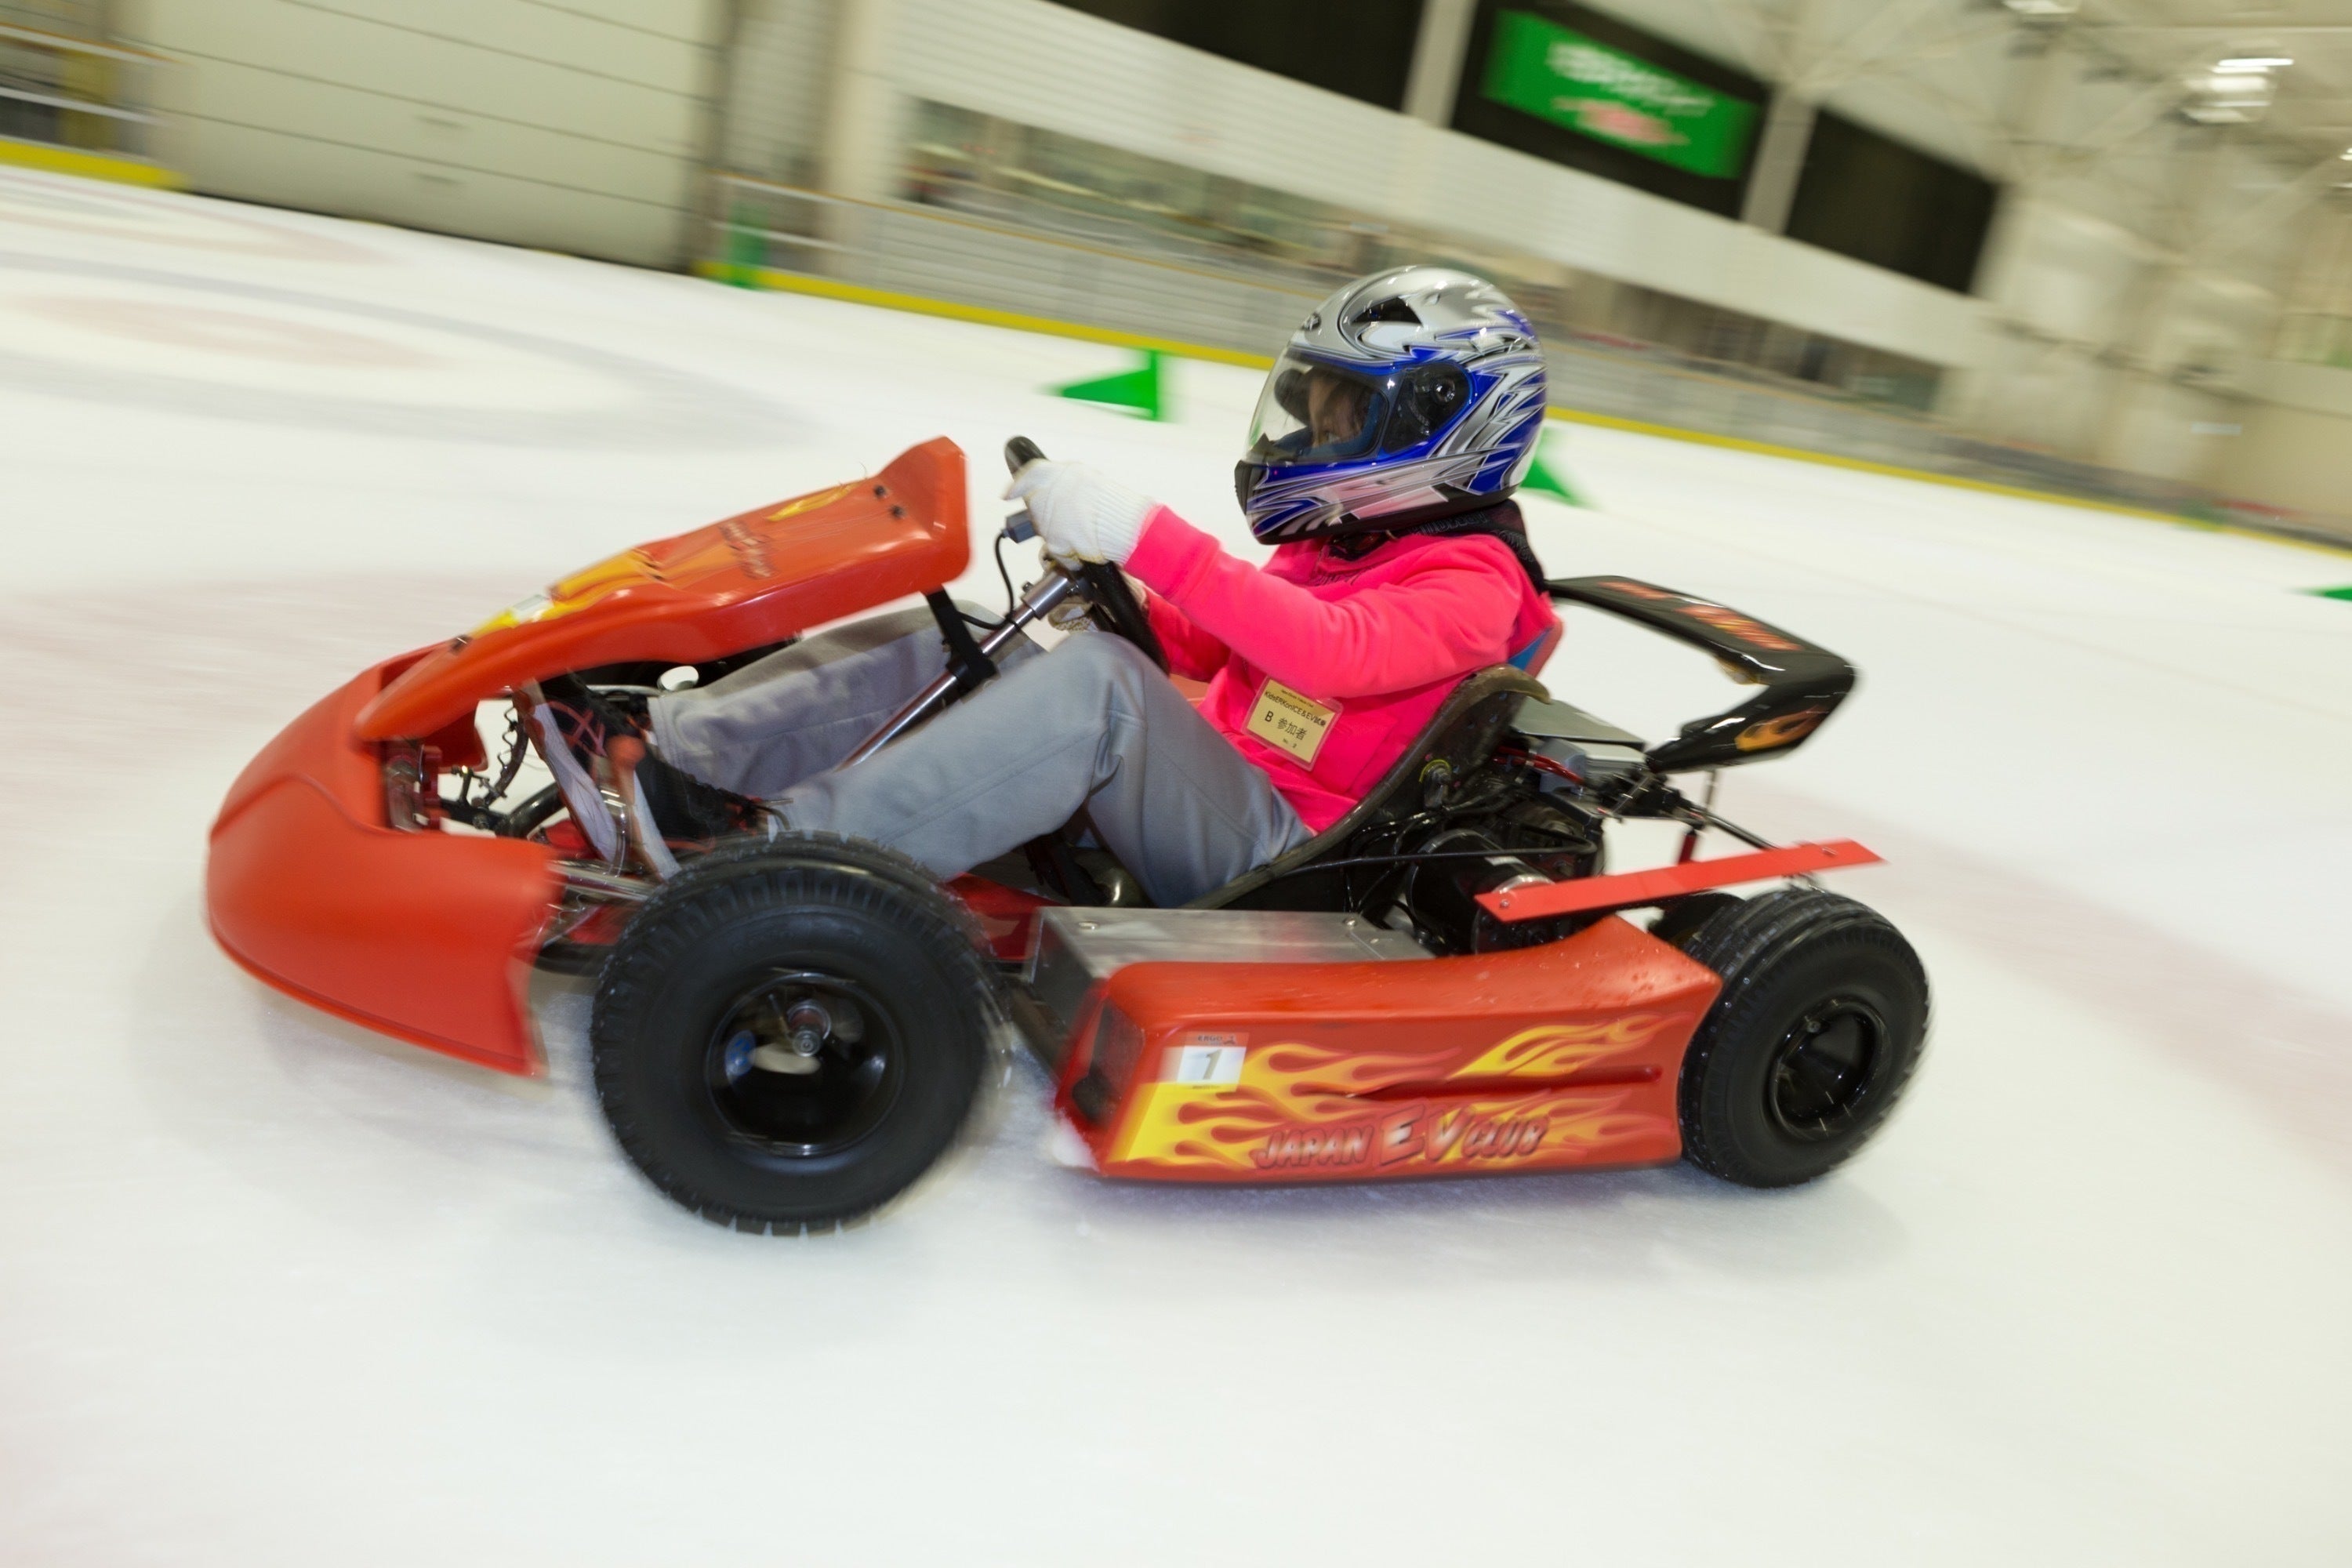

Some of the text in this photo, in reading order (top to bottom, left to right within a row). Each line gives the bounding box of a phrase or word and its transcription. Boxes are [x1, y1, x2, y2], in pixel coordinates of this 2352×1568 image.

[1265, 710, 1308, 741] B 参加者
[1202, 1048, 1223, 1080] 1
[1256, 1104, 1550, 1170] JAPAN EV CLUB
